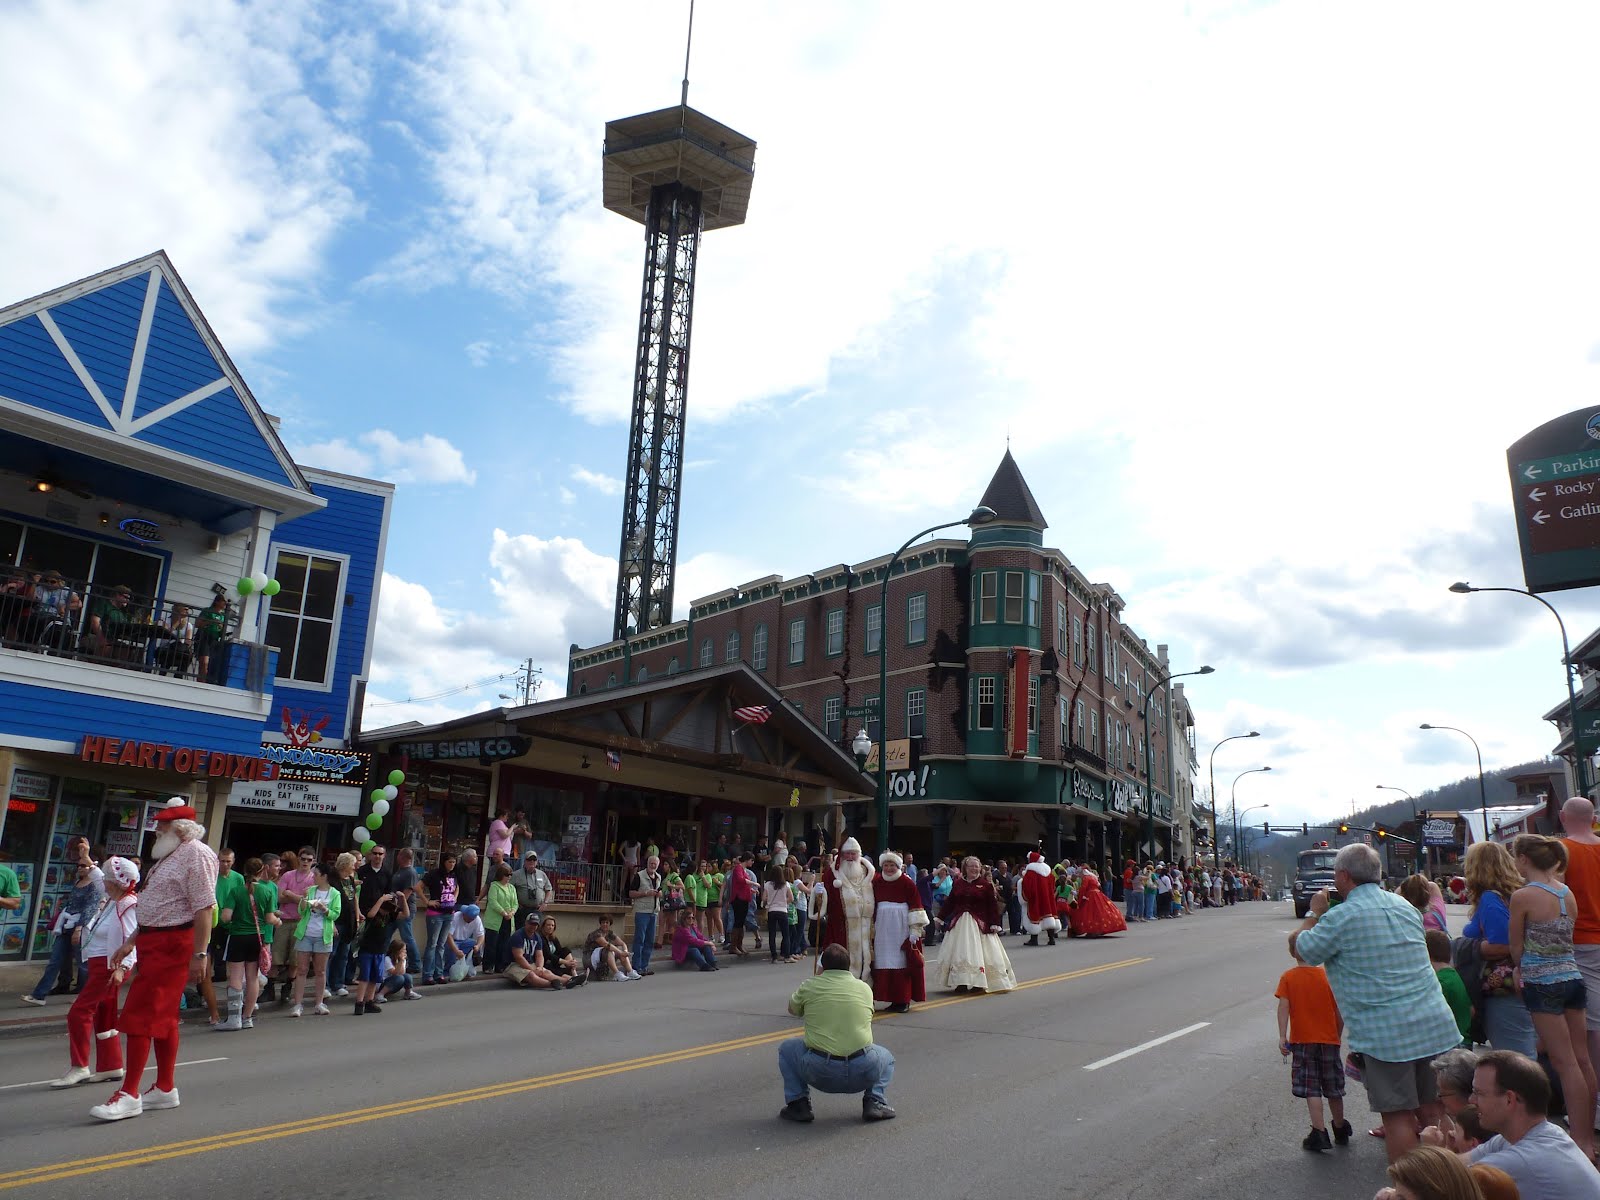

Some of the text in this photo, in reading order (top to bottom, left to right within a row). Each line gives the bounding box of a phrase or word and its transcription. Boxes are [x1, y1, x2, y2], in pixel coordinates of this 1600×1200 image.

[1554, 481, 1595, 496] Rocky
[400, 739, 517, 759] THE SIGN CO.
[82, 735, 280, 781] HEART OF DIXIE
[303, 770, 328, 778] OYSTER
[17, 775, 48, 786] HENNA
[16, 785, 46, 796] TATTOOS
[277, 782, 309, 792] OYSTERS
[255, 789, 320, 802] KIDS EAT FREE
[241, 797, 276, 807] KARAOKE
[112, 832, 133, 843] HENNA
[107, 843, 136, 854] TATTOOS
[523, 938, 537, 956] NY
